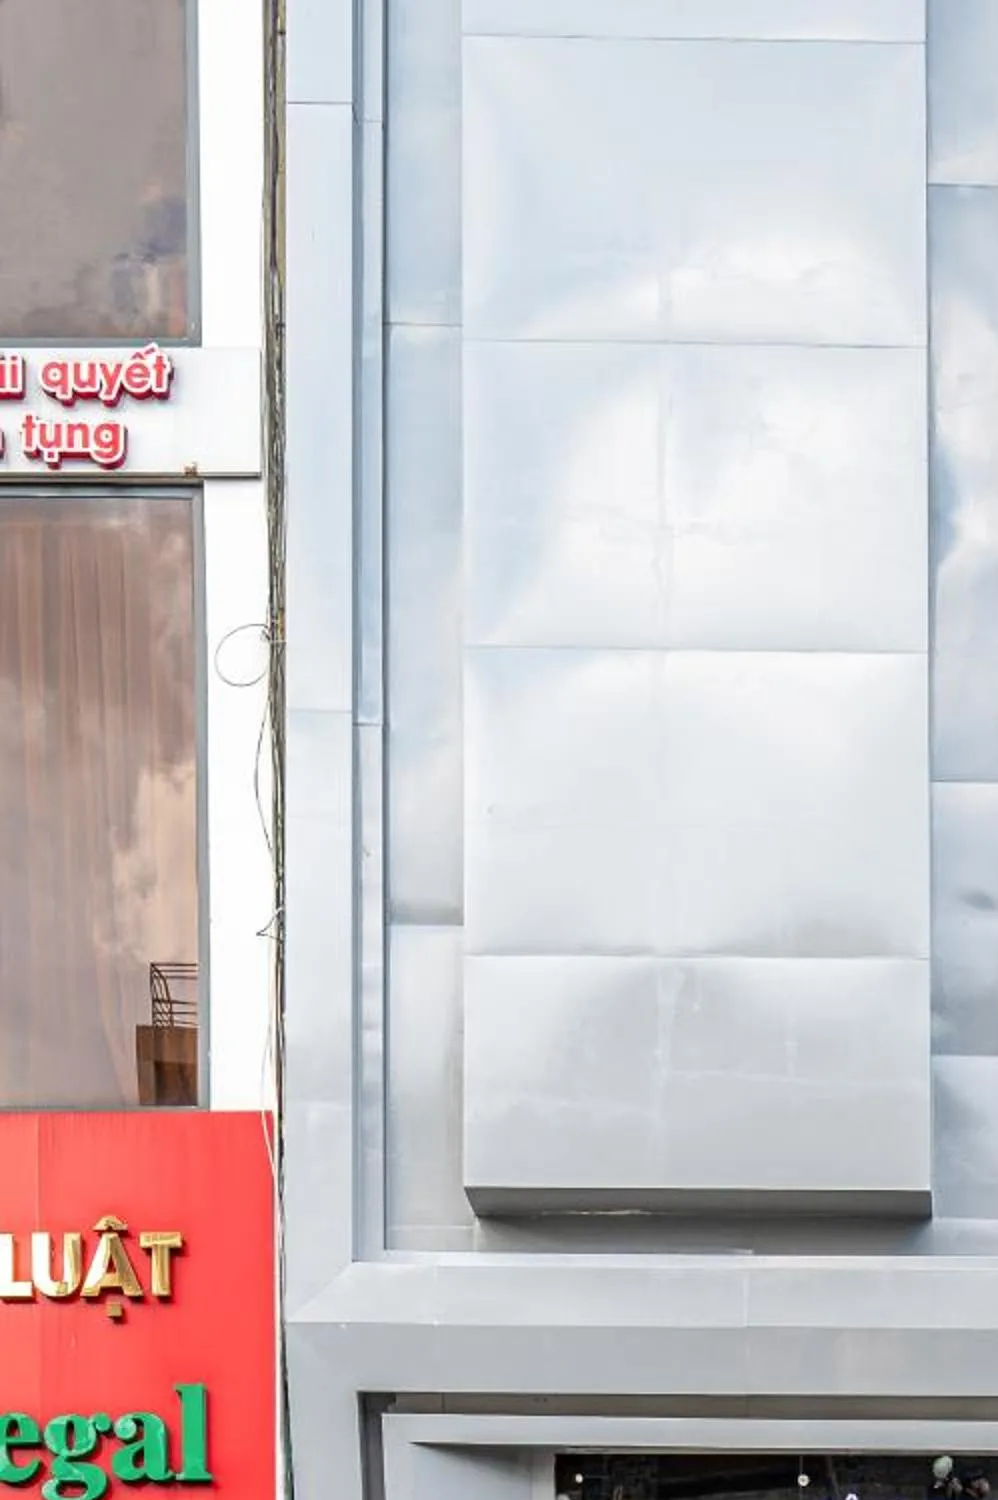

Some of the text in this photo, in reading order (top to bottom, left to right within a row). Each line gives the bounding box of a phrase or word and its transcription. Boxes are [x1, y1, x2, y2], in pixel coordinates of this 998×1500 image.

[41, 344, 172, 404] quyết
[22, 413, 126, 466] tụng
[0, 1215, 183, 1317] LUẬT
